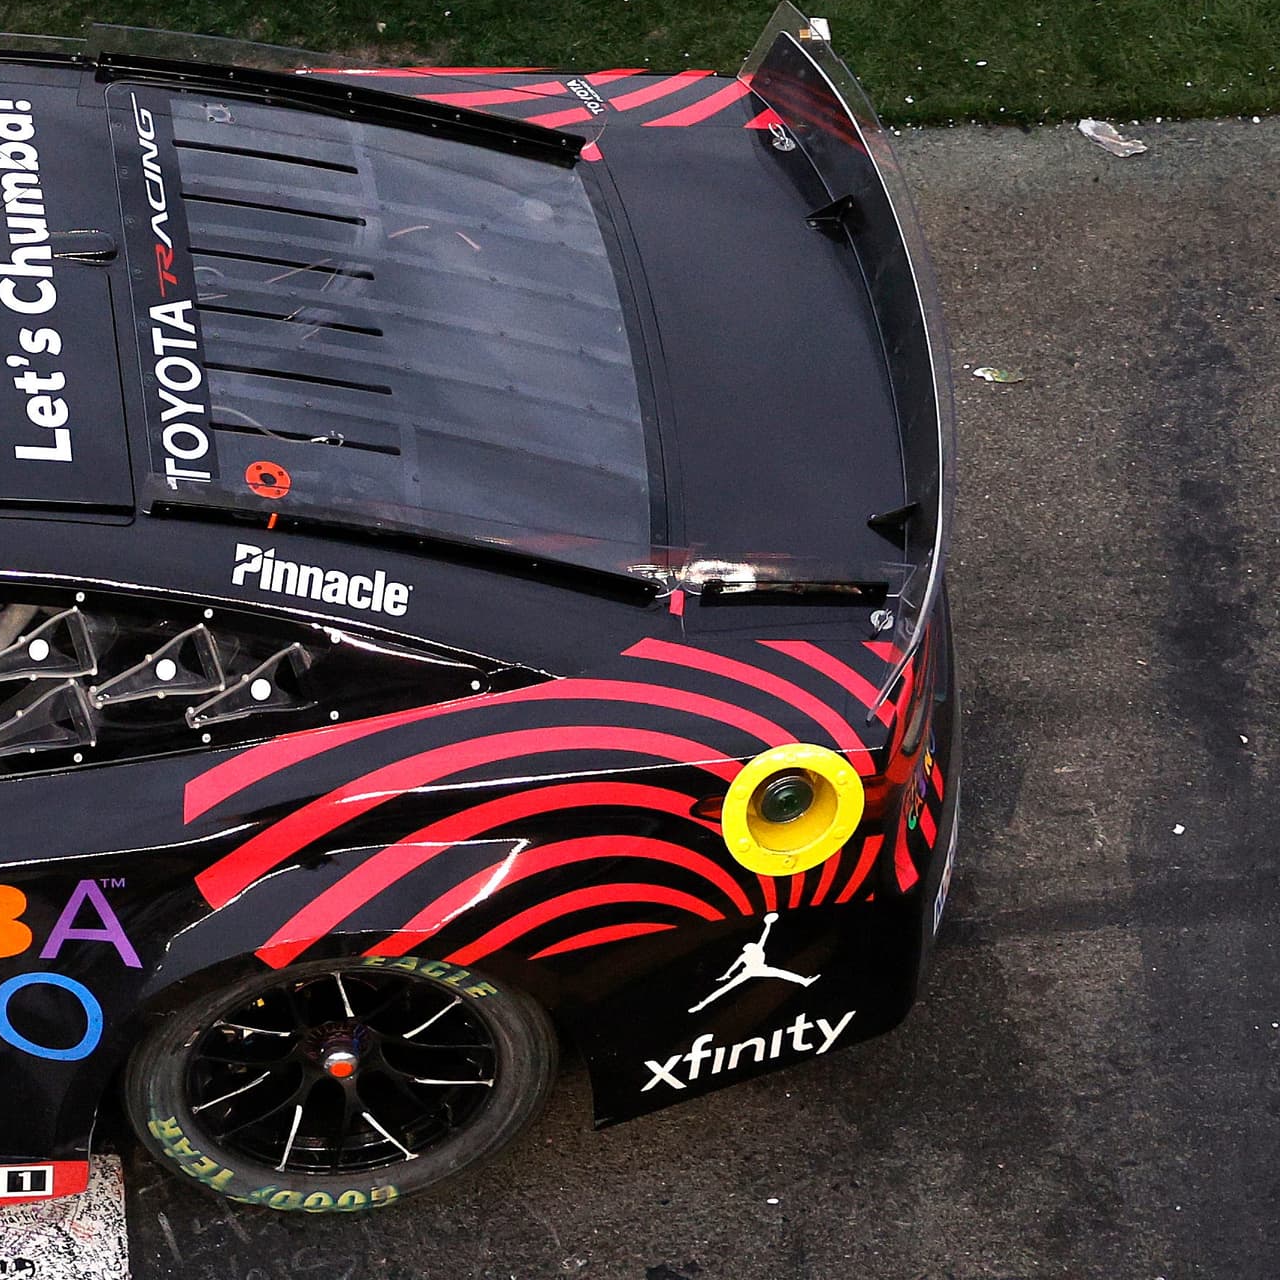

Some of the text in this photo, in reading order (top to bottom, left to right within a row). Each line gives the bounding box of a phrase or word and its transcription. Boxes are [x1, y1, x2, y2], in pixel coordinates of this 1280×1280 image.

[130, 91, 213, 492] TOYOTA RACING
[5, 326, 73, 463] Let's
[231, 542, 412, 617] Pinnacle
[360, 953, 501, 999] EAGLE
[640, 1009, 857, 1094] xfinity
[17, 1171, 32, 1192] 1
